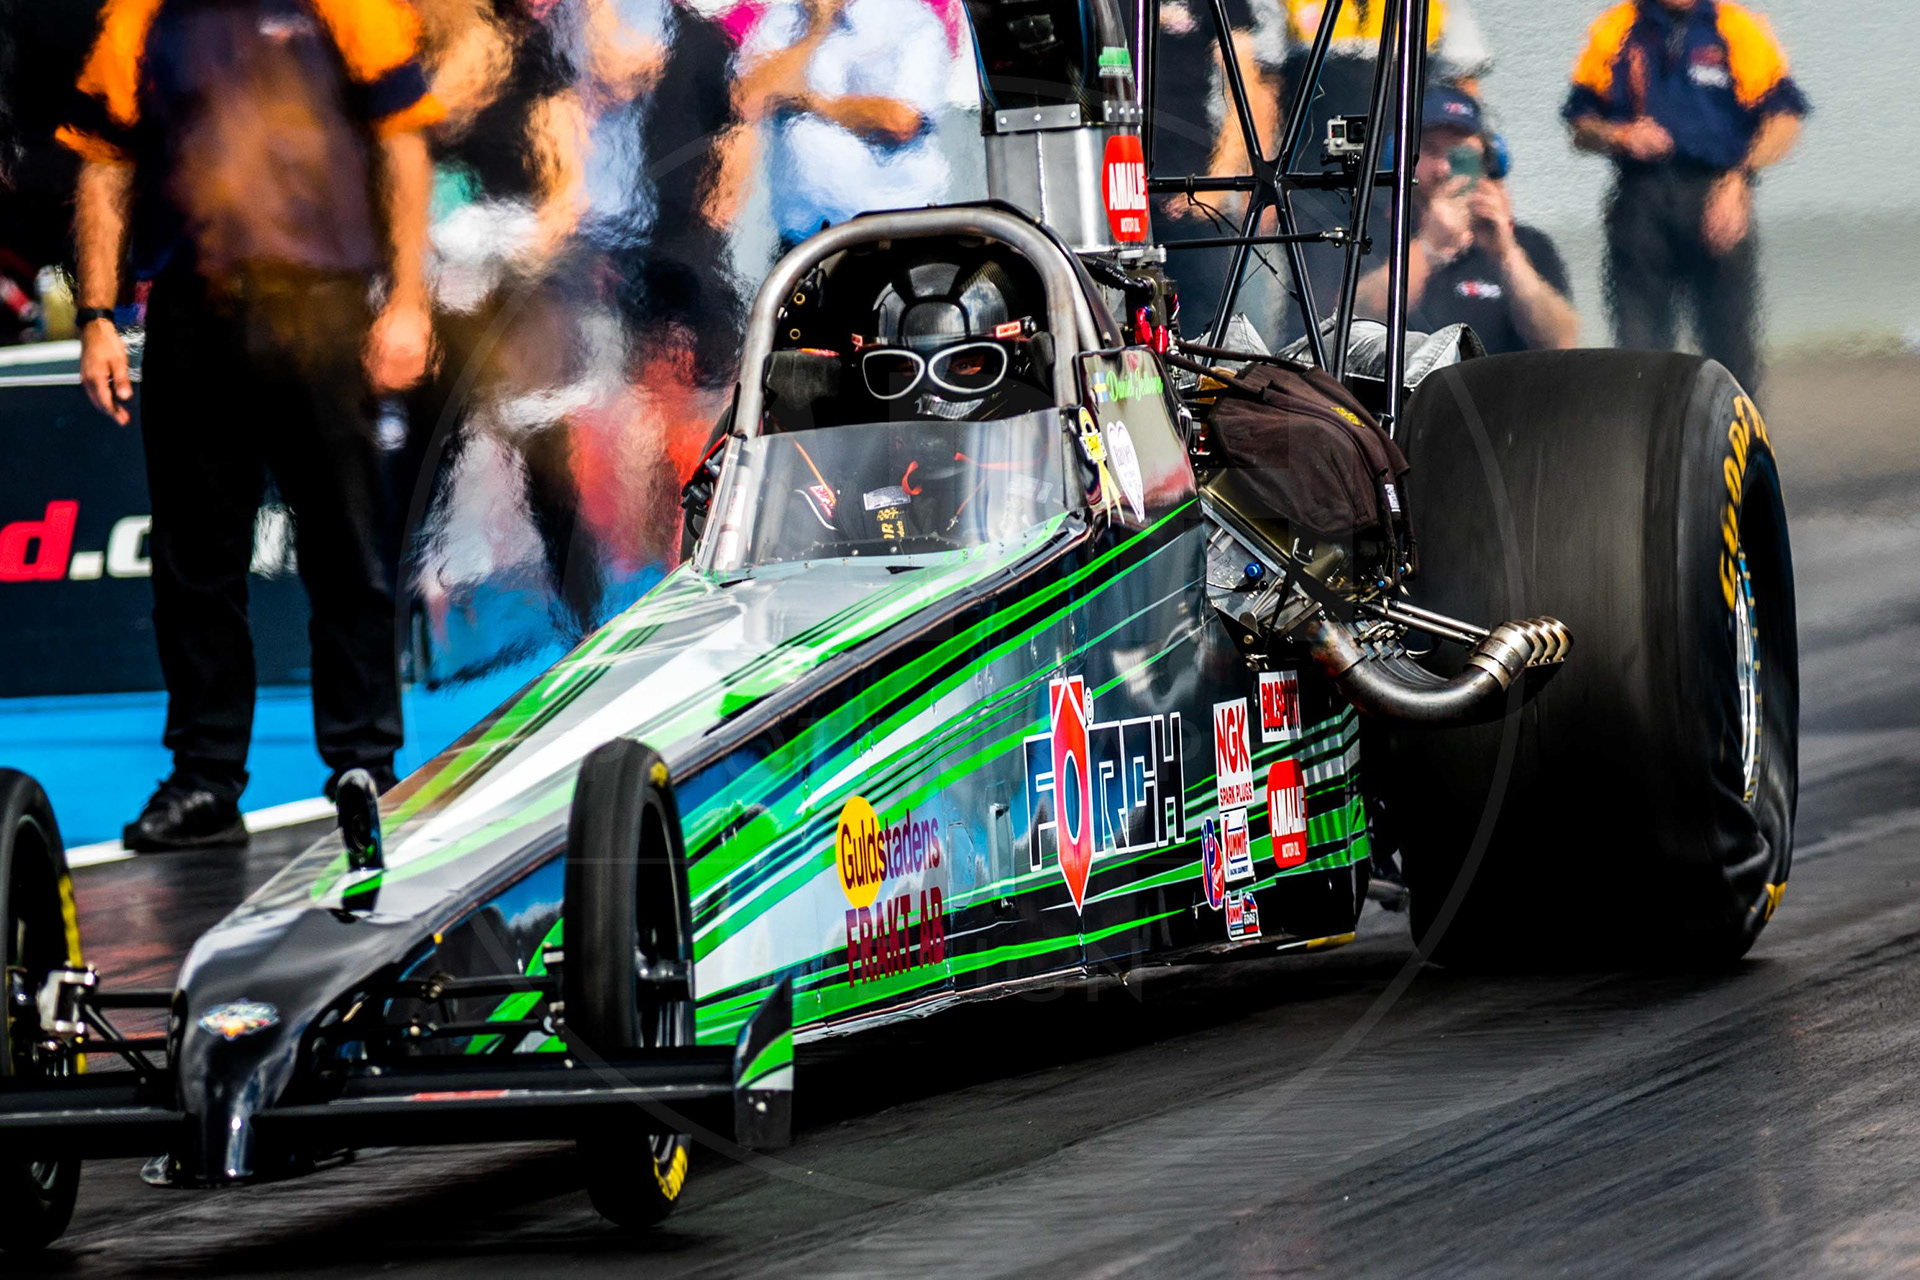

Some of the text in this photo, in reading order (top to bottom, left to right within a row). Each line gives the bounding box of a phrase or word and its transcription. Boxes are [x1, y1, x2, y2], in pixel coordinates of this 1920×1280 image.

[1109, 162, 1146, 210] AMALIE
[1215, 703, 1250, 777] NGK
[1220, 782, 1253, 806] SPARK PLUGS
[1270, 786, 1306, 837] AMALIE
[841, 808, 941, 890] Guldstadens
[845, 886, 945, 988] FRAKT AB
